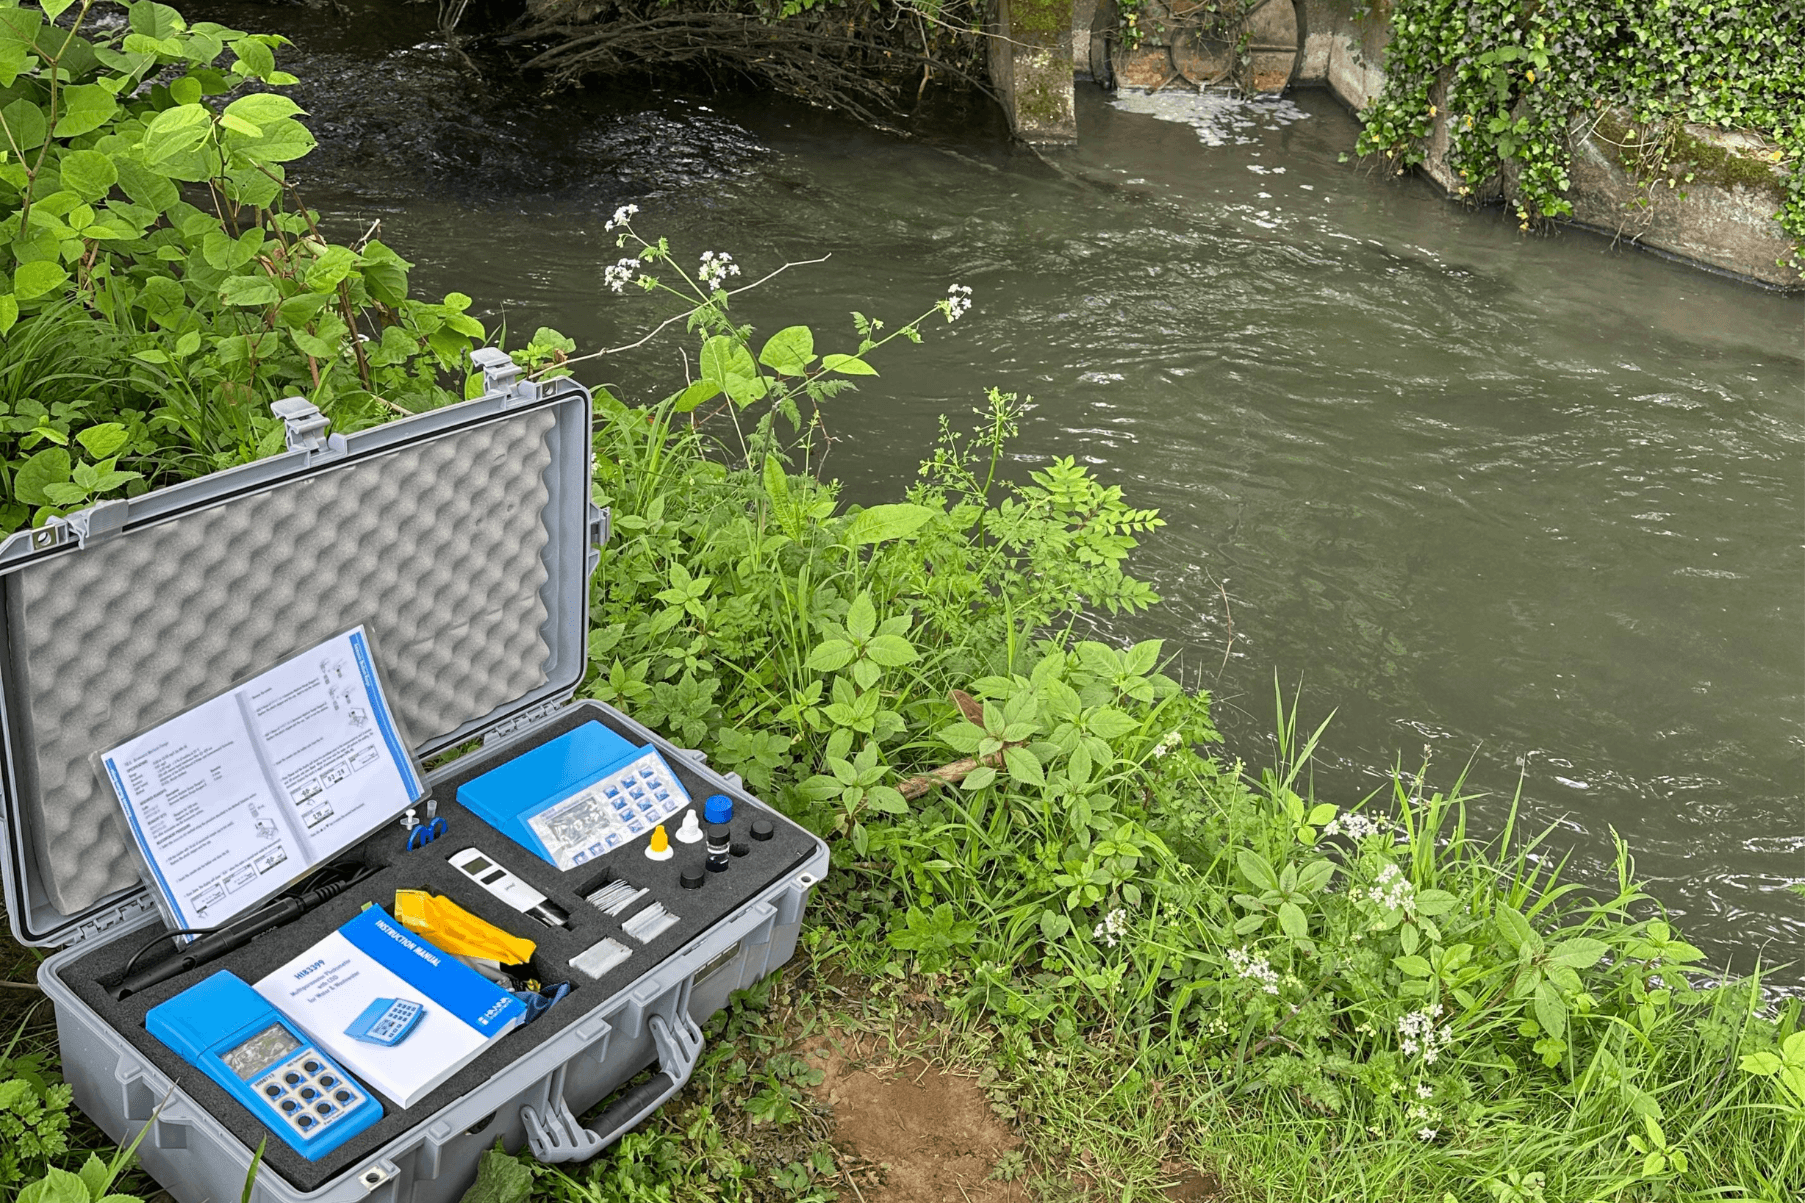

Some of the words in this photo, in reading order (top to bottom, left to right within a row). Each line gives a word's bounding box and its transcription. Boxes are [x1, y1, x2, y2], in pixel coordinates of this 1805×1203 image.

[374, 919, 417, 951] INSTRUCTION
[413, 946, 441, 968] MANUAL
[293, 958, 325, 980] HI83399
